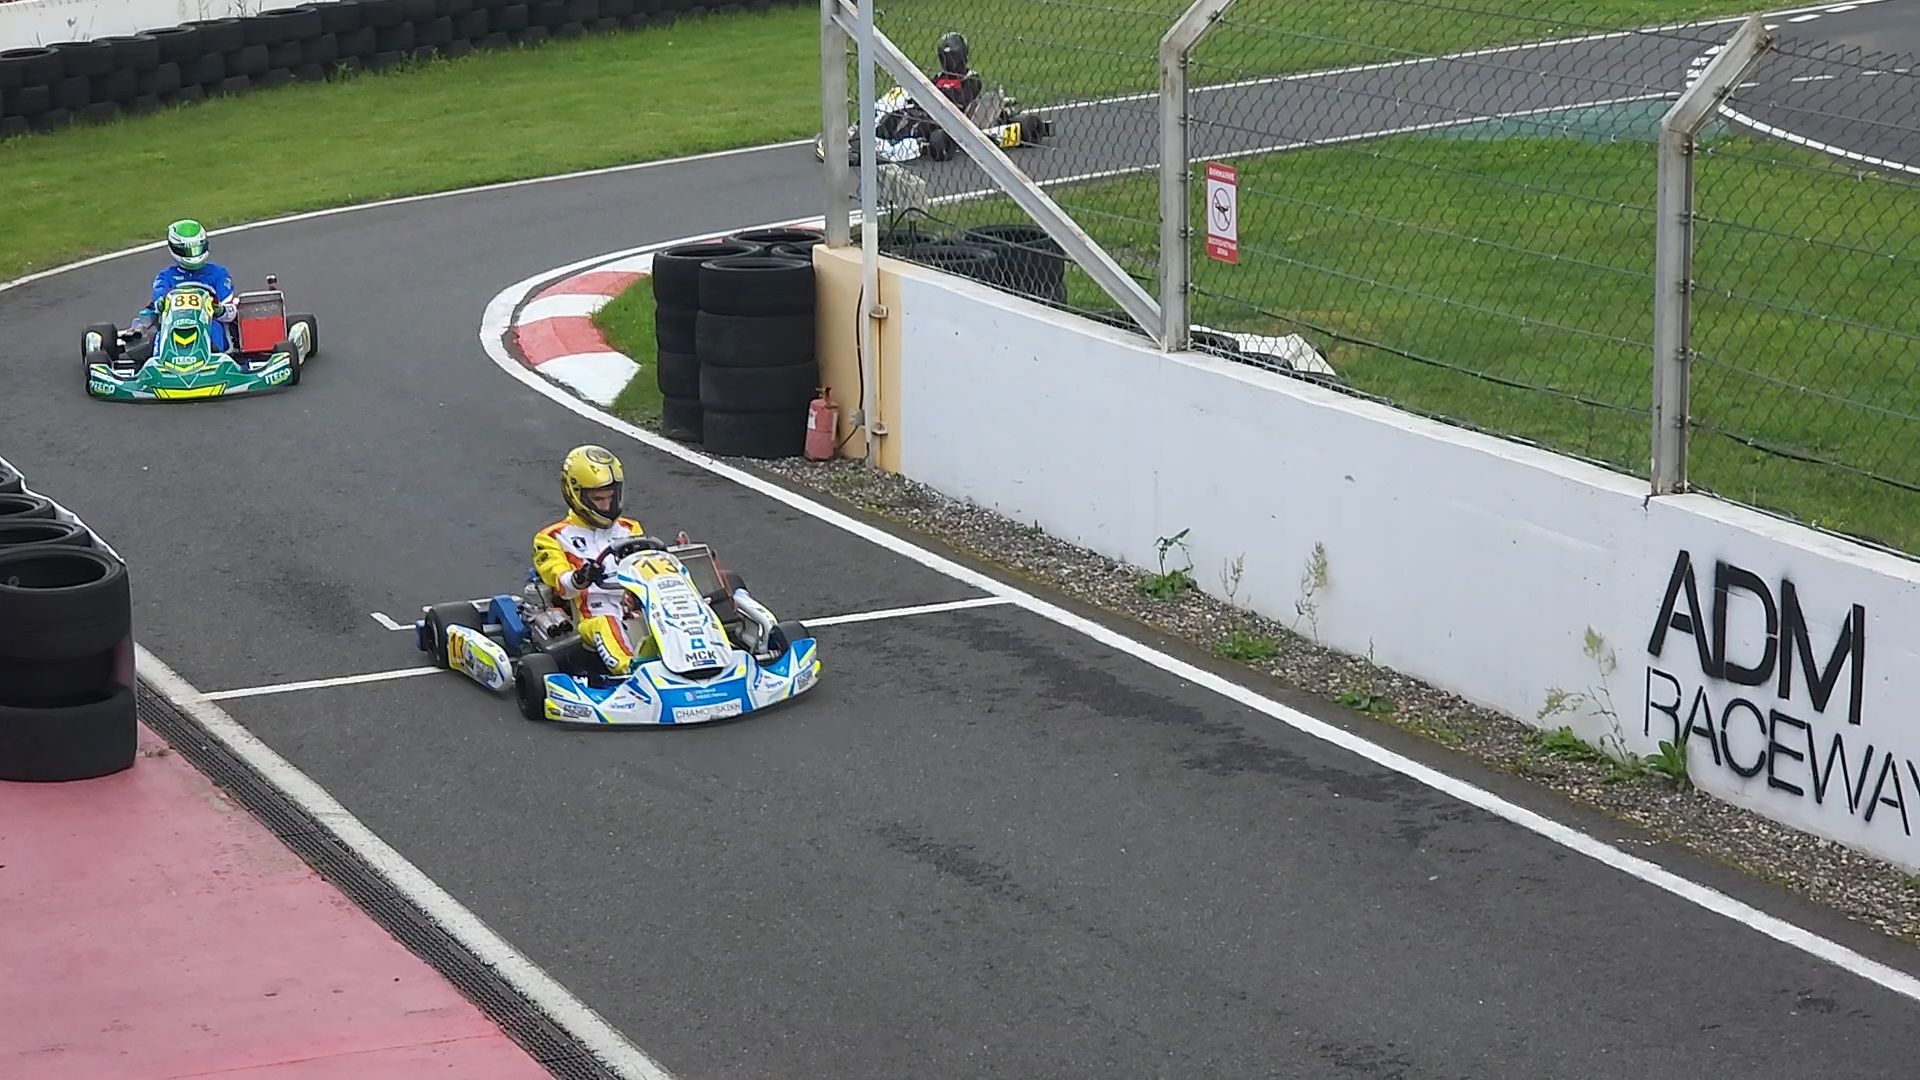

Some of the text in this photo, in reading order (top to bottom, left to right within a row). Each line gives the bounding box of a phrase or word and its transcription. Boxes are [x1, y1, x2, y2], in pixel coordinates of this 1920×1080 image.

[175, 295, 200, 307] 88
[265, 368, 291, 384] ITECO
[641, 558, 679, 574] 13
[1647, 549, 1865, 726] ADM
[685, 650, 717, 662] MCK
[1643, 665, 1920, 837] RACEWA
